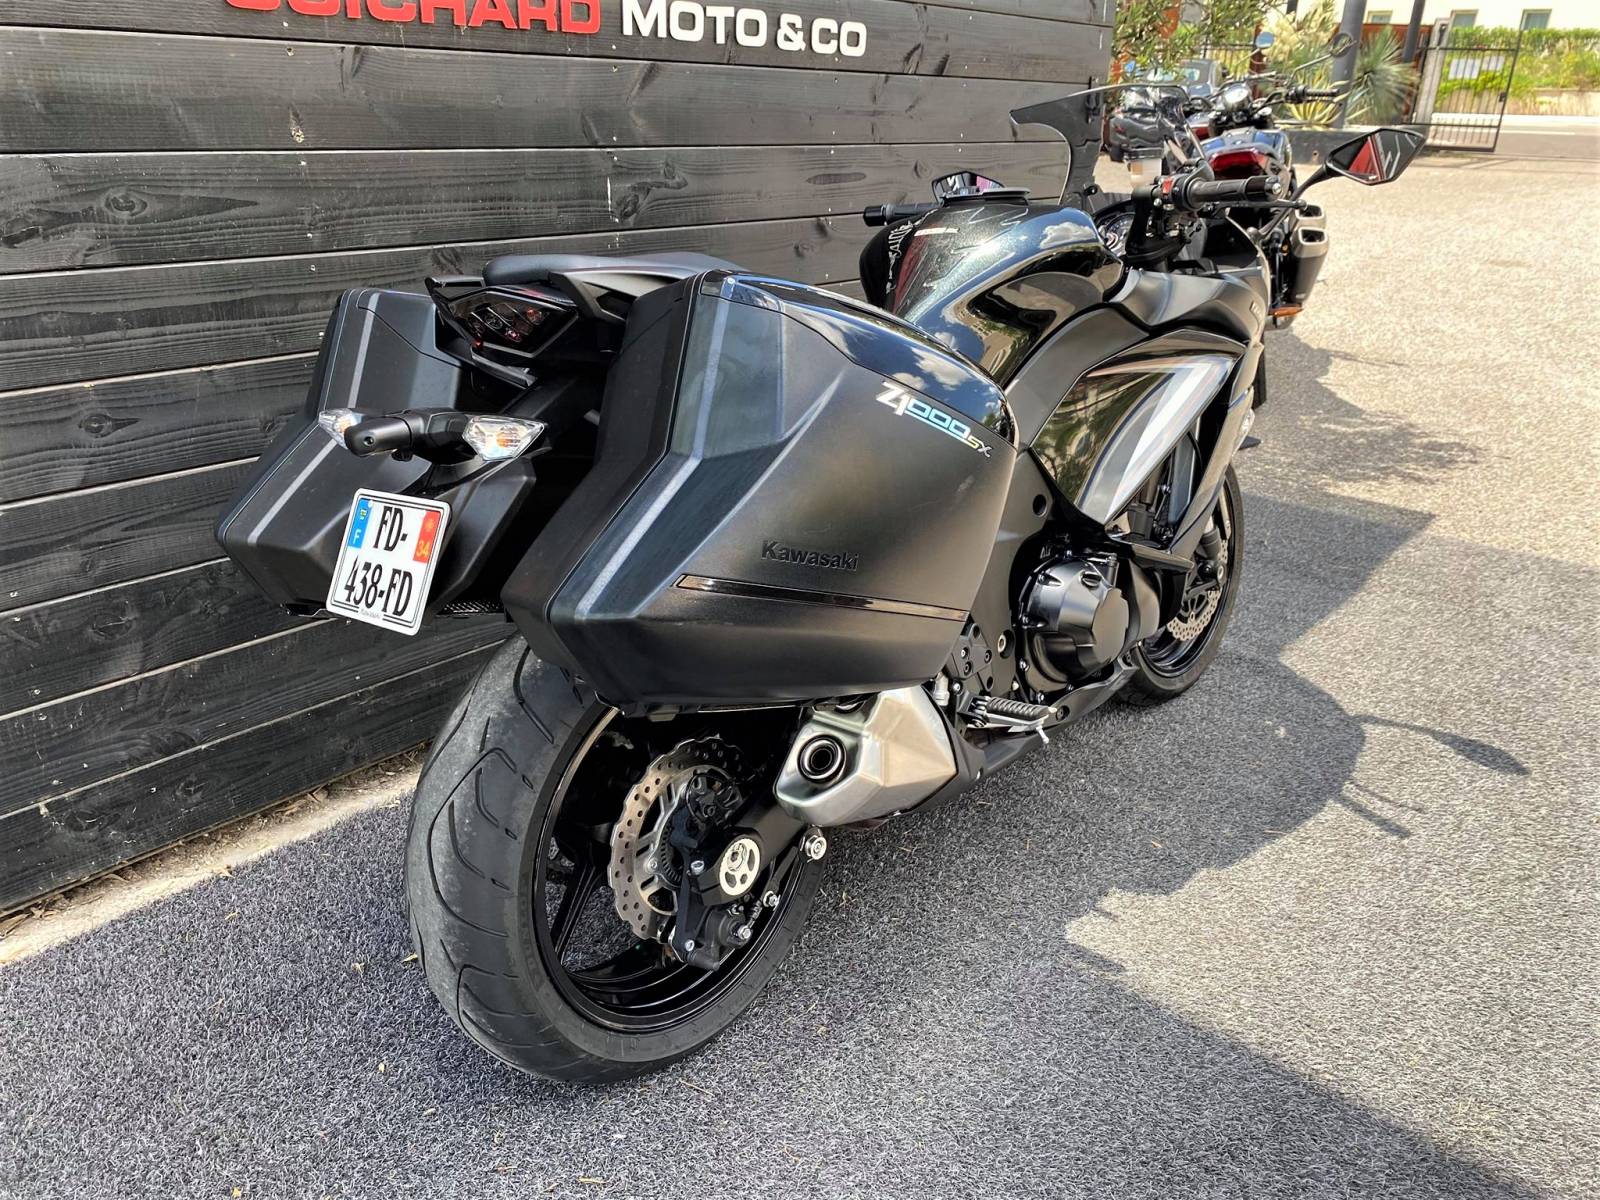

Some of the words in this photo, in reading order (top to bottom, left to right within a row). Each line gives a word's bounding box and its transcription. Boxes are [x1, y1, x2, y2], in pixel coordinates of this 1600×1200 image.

[226, 0, 601, 33] HARD
[622, 0, 768, 47] MOTO
[776, 13, 807, 51] &
[811, 18, 867, 57] CO
[761, 540, 860, 571] Kawasaki
[344, 555, 413, 617] 438-FD
